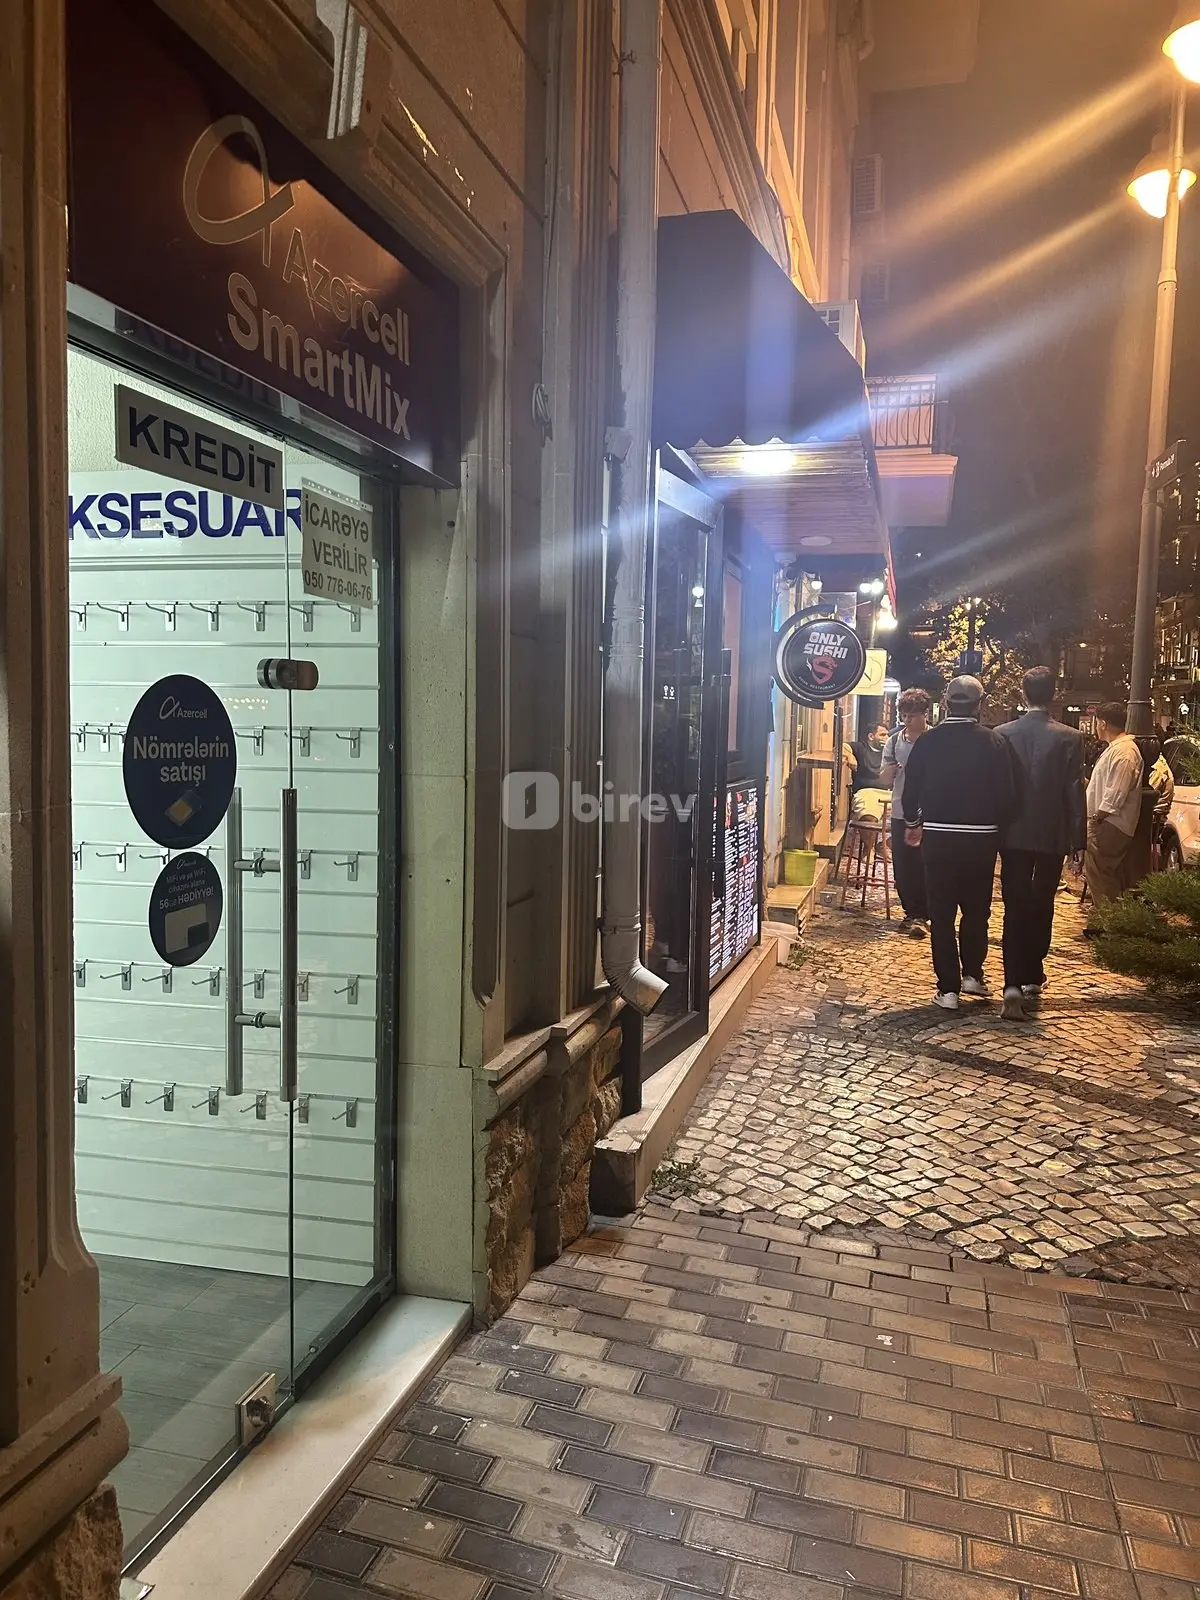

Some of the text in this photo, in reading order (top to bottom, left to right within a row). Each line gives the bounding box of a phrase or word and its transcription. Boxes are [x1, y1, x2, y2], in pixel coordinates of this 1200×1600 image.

[283, 227, 410, 366] Azercell
[227, 272, 411, 440] SmartMix
[128, 406, 276, 494] KREDİT
[305, 494, 369, 543] İCARƏYƏ
[312, 538, 368, 577] VERİLİR
[304, 570, 372, 601] 050 776-06-76
[803, 643, 848, 659] SUSHI
[809, 631, 846, 646] ONLY
[177, 707, 208, 719] Azercell
[132, 735, 229, 760] Nömrələrin
[160, 760, 206, 786] satışı
